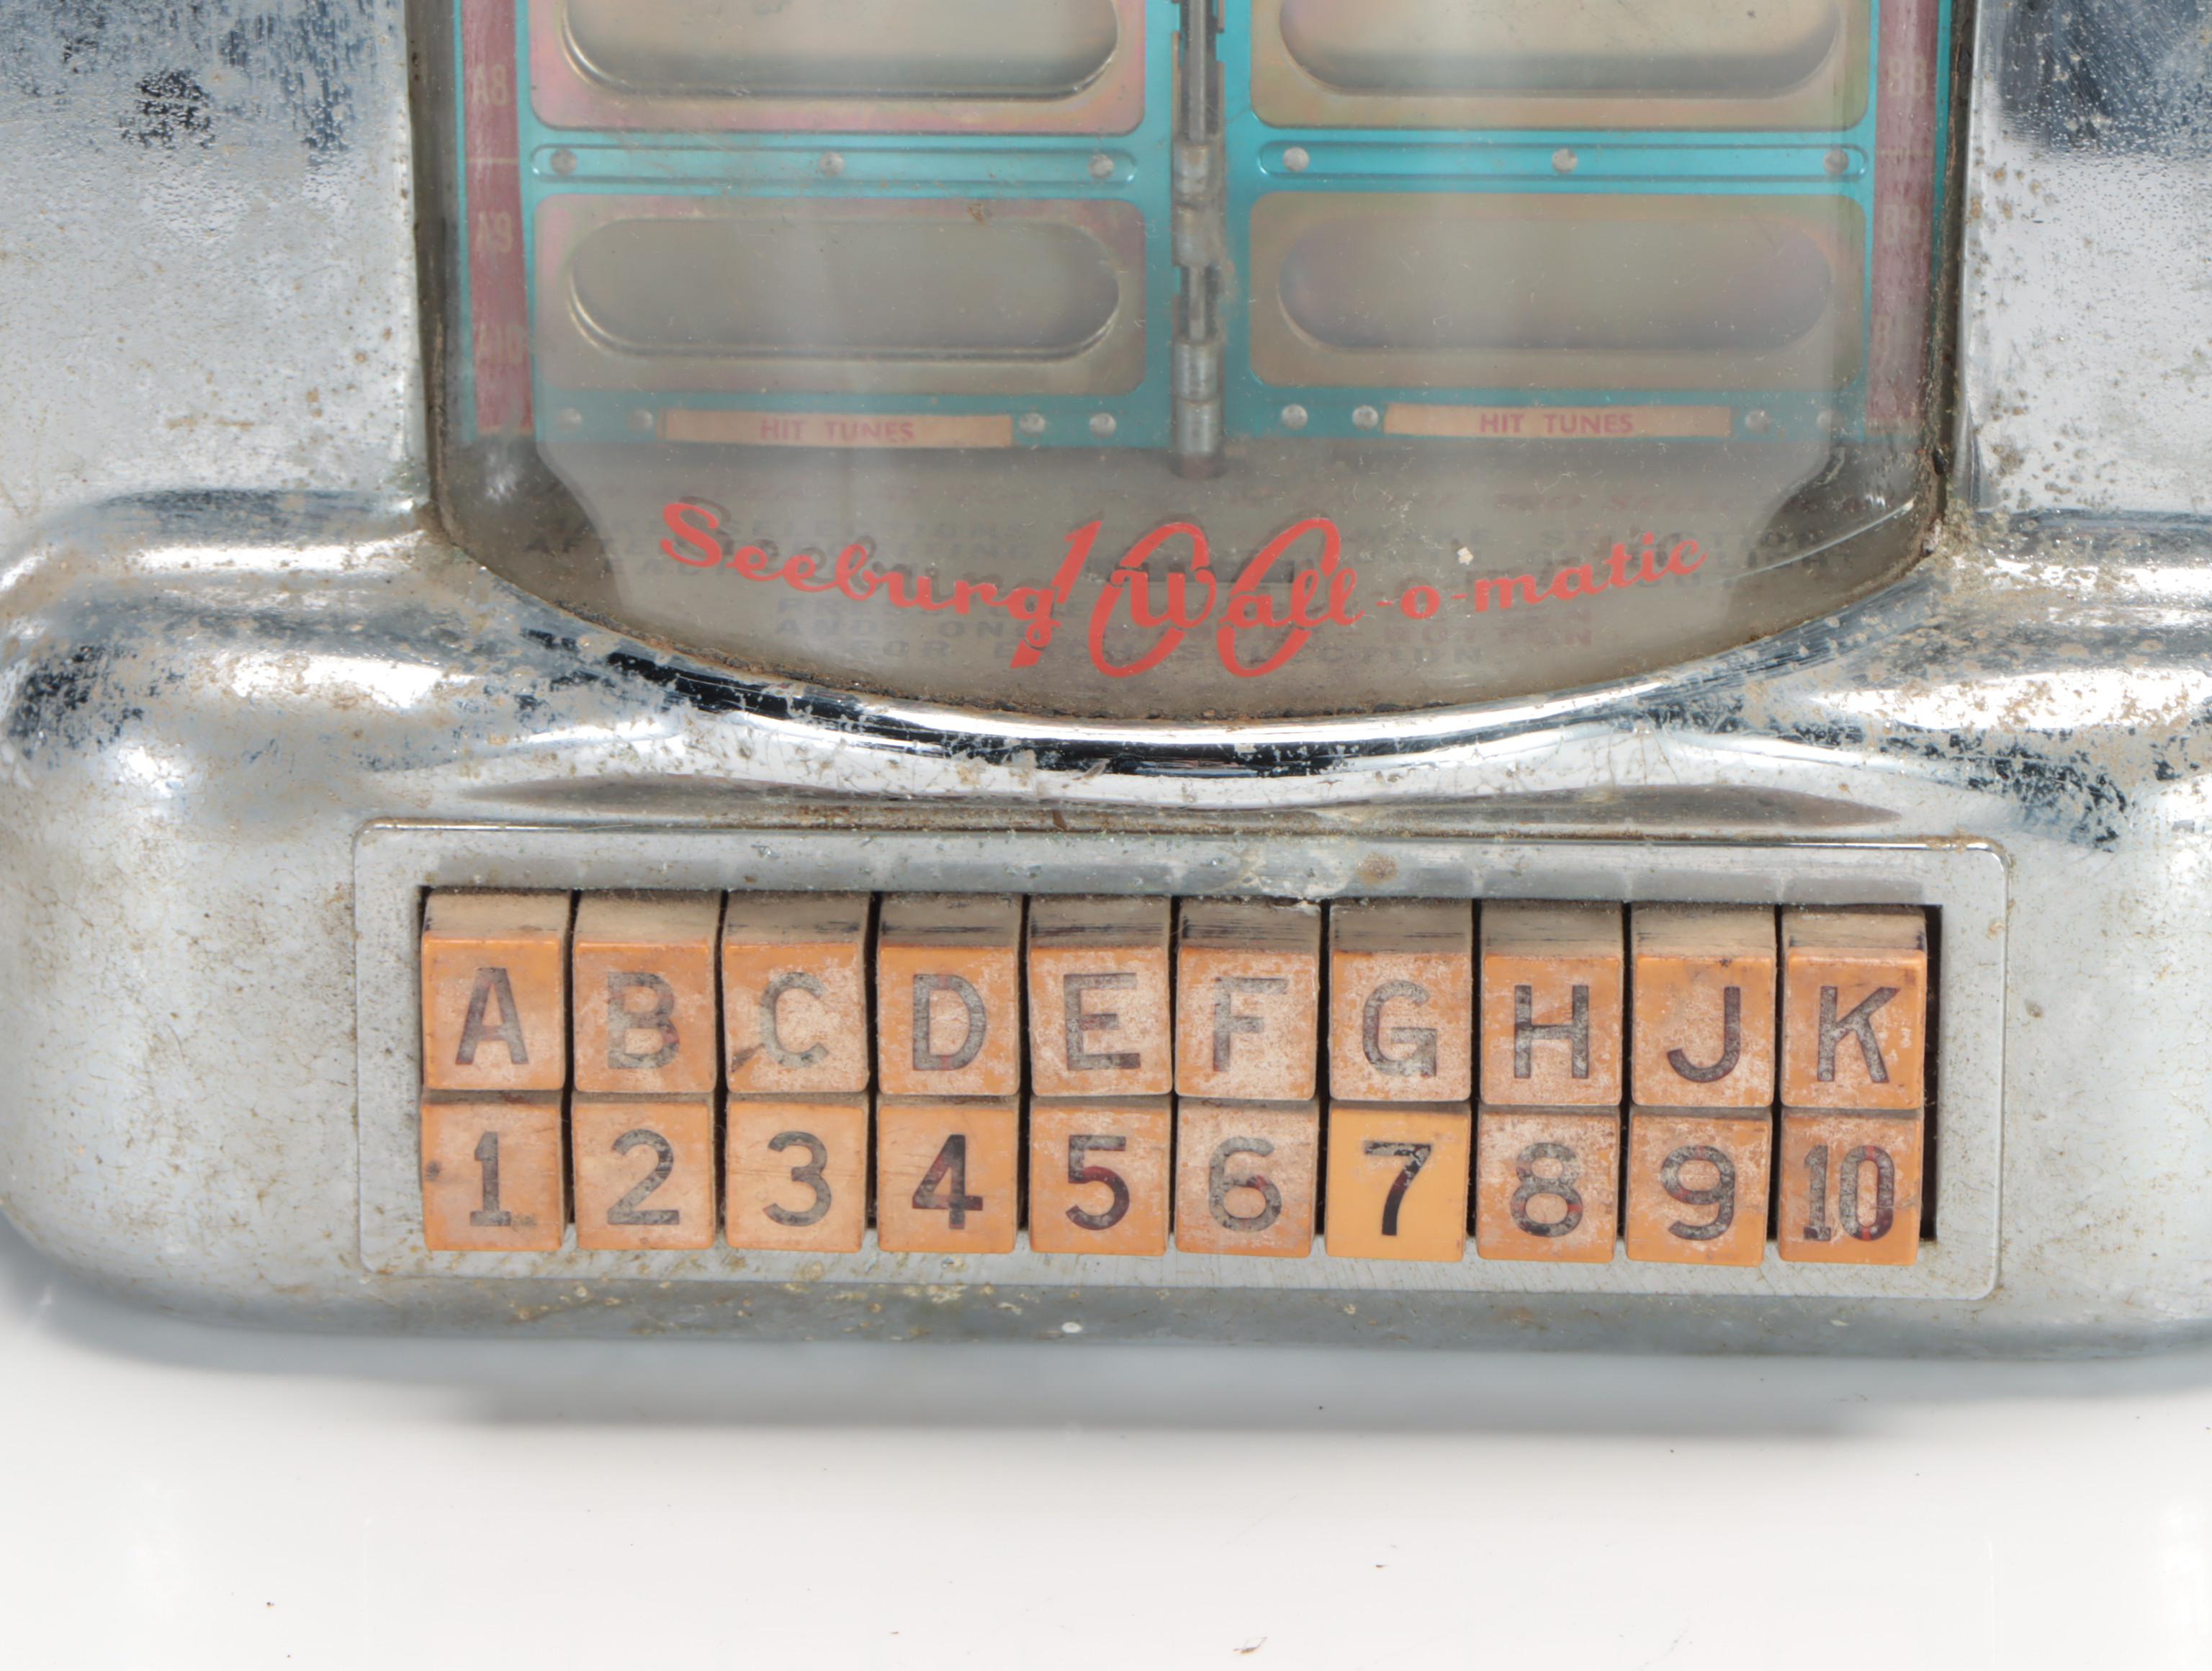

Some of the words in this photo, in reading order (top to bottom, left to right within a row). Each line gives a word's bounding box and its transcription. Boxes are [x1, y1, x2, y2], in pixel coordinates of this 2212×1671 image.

[470, 64, 509, 107] A8
[475, 212, 513, 254] A9
[760, 418, 805, 440] HIT
[824, 420, 915, 442] TUNES
[1480, 413, 1524, 433] HIT
[1544, 413, 1634, 434] TUNES
[660, 503, 1061, 648] Seeburg
[456, 967, 529, 1065] A
[607, 972, 680, 1069] B
[760, 972, 829, 1068] C
[912, 974, 986, 1070] D
[1064, 973, 1141, 1070] E
[1213, 977, 1288, 1072] F
[1363, 980, 1437, 1078] G
[1514, 985, 1589, 1078] H
[1667, 986, 1740, 1083] J
[1817, 986, 1900, 1083] K
[469, 1131, 511, 1226] 1
[607, 1129, 680, 1224] 2
[763, 1131, 832, 1226] 3
[912, 1134, 983, 1229] 4
[1065, 1134, 1130, 1230] 5
[1208, 1137, 1282, 1232] 6
[1364, 1140, 1431, 1236] 7
[1512, 1142, 1583, 1237] 8
[1662, 1145, 1735, 1240] 9
[1803, 1145, 1894, 1241] 10
